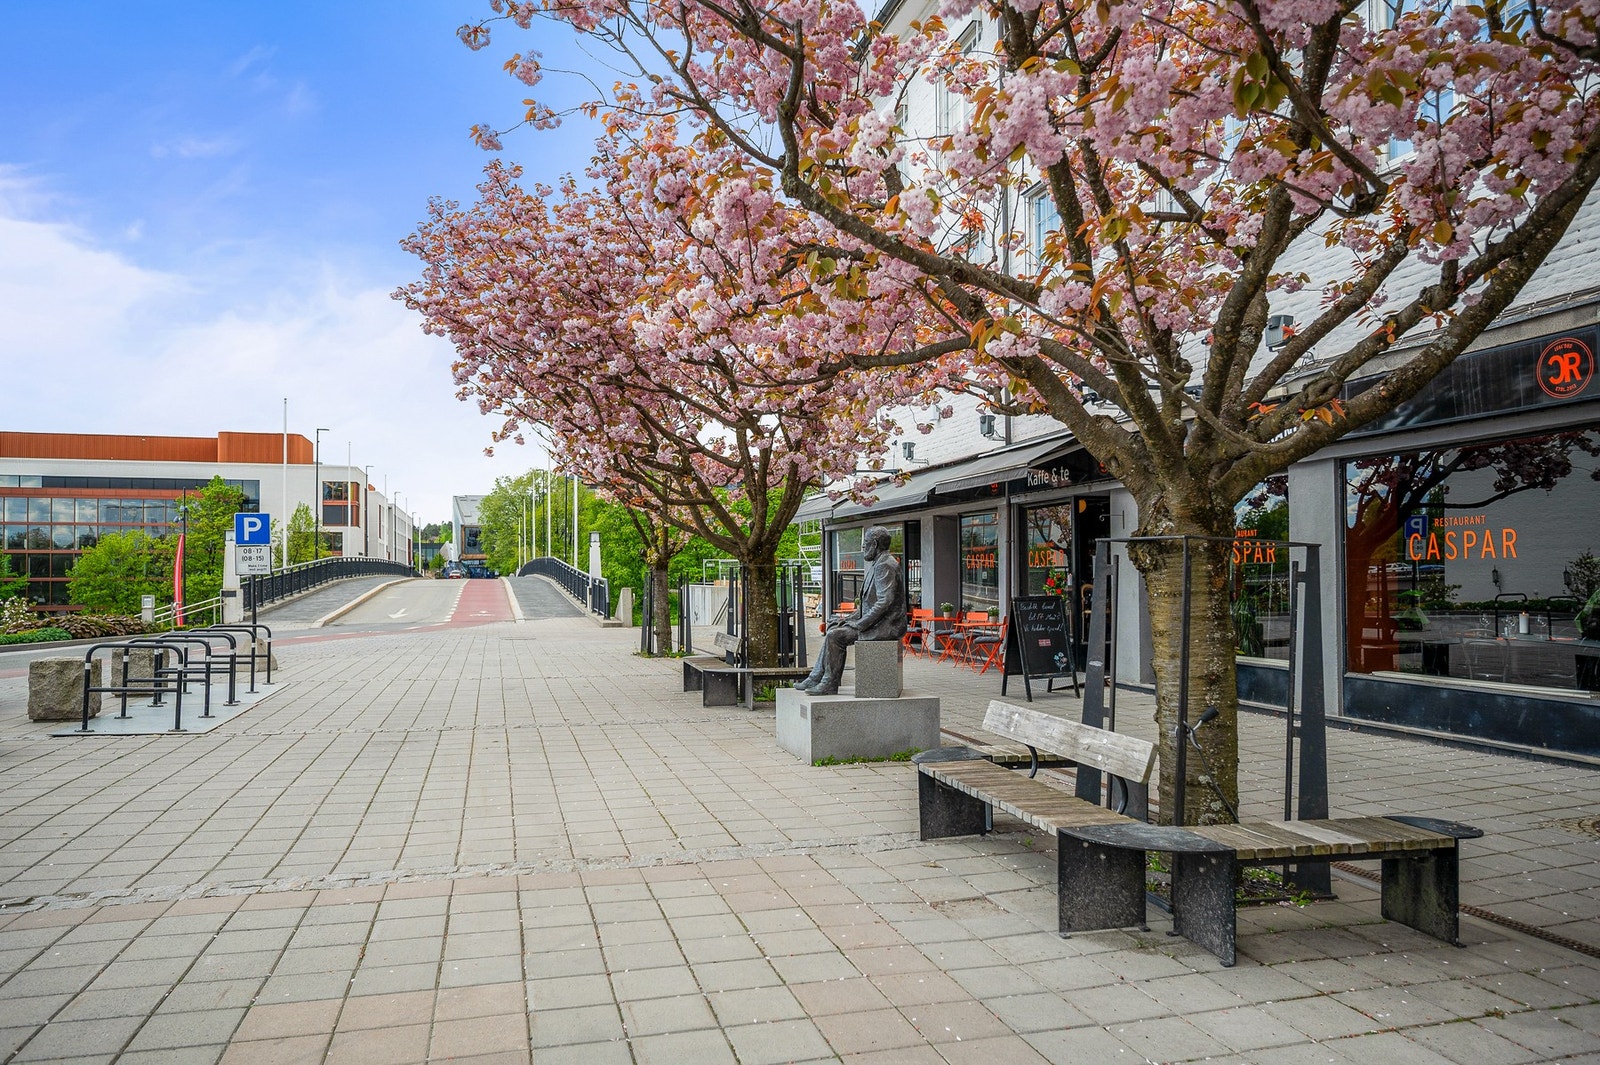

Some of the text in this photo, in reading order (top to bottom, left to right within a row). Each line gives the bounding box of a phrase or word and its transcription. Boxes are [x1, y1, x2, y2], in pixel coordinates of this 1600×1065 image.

[1027, 466, 1070, 487] Kaffe & te
[243, 517, 262, 541] P
[1434, 515, 1487, 527] RESTAURANT
[1409, 527, 1518, 562] CASPAR
[966, 553, 995, 569] CASPAR
[1028, 548, 1064, 567] CASPAR
